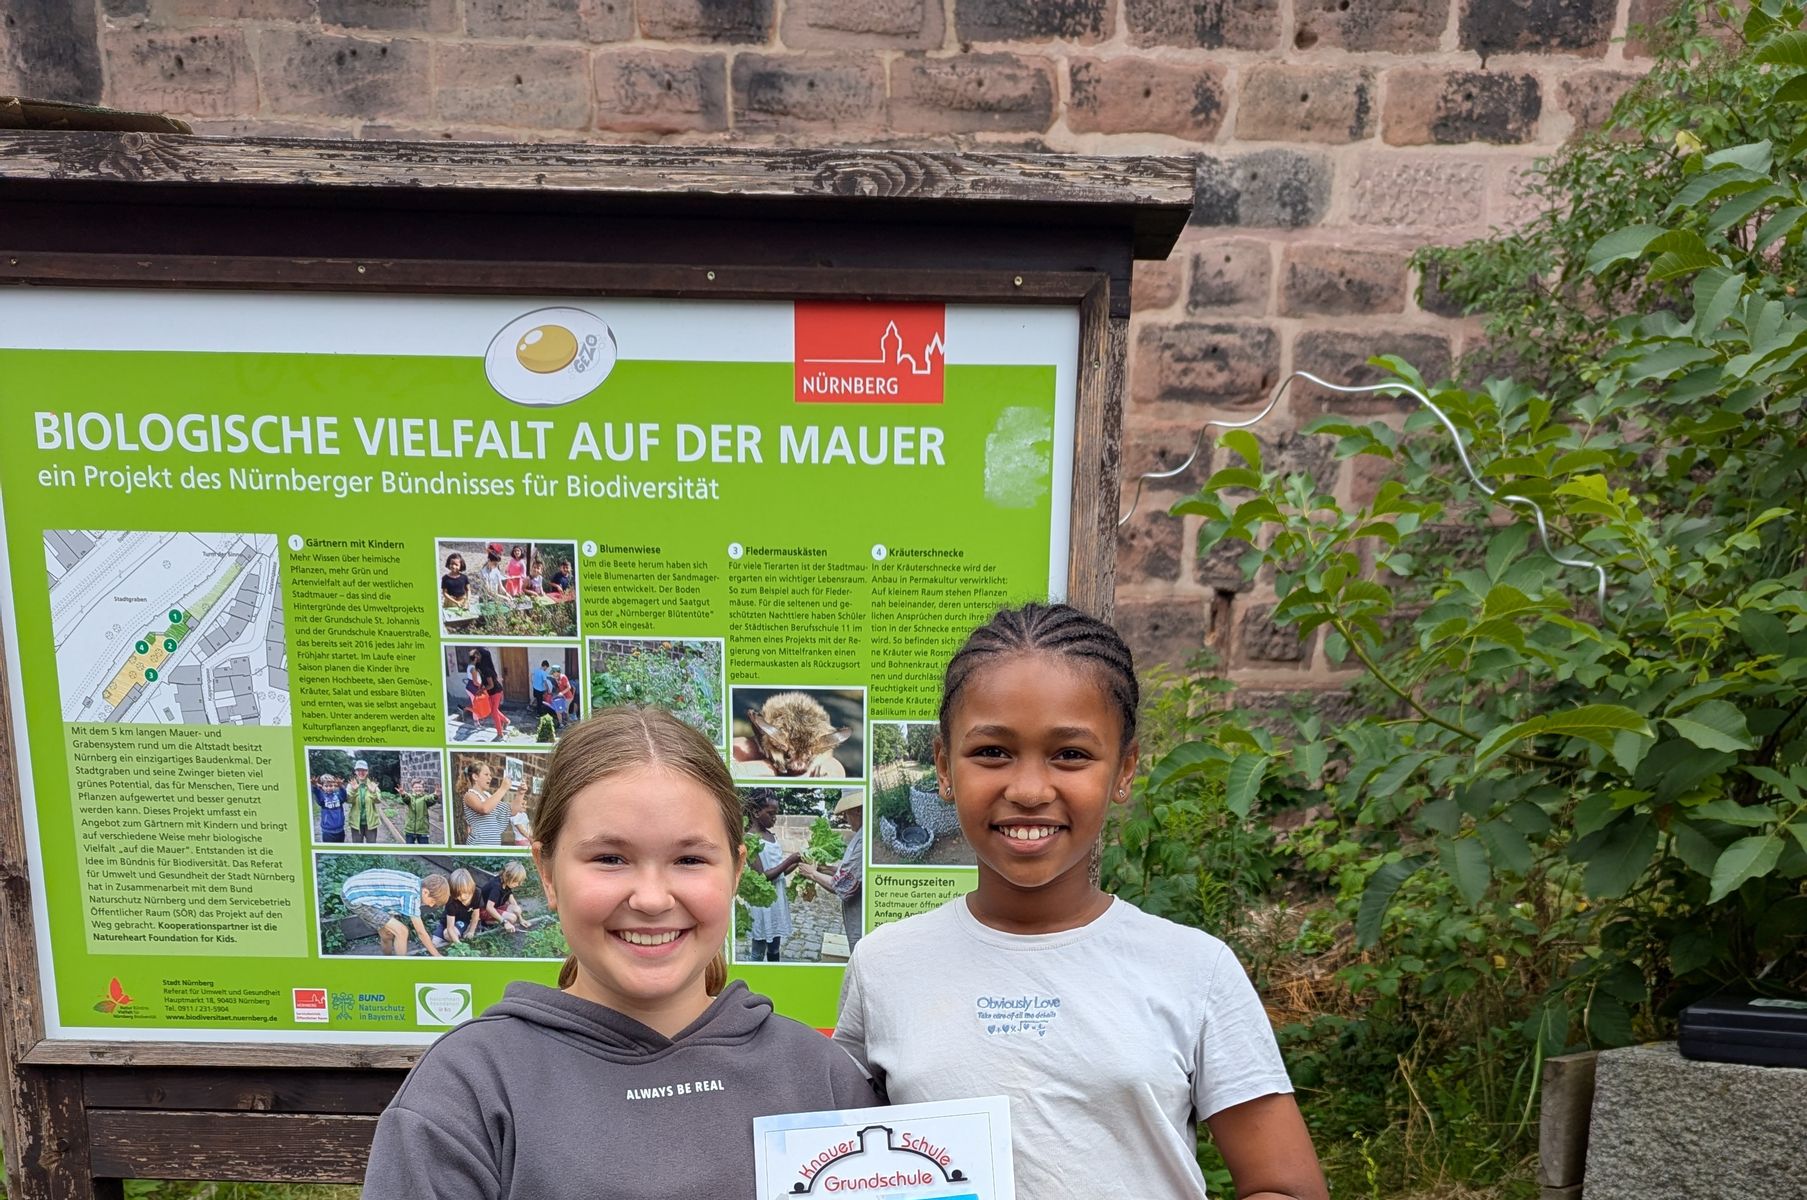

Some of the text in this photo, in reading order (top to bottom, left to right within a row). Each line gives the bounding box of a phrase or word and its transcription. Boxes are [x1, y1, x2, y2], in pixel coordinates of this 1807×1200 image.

[573, 334, 598, 373] GEZO
[803, 372, 897, 394] NÜRNBERG
[34, 411, 945, 465] BIOLOGISCHE VIELFALT AUF DER MAUER
[38, 464, 719, 499] ein Projekt des Nürnberger Bündnisses für Biodiversität
[306, 538, 347, 547] Gärtnern
[350, 538, 365, 548] mit
[367, 539, 404, 548] Kindern
[599, 544, 660, 554] Blumenwiese
[745, 546, 827, 557] Fledermauskästen
[889, 548, 963, 558] Kräuterschnecke
[289, 553, 400, 564] Mehr Wissen über heimische
[582, 559, 707, 569] Um die Beete herum haben sich
[290, 565, 388, 576] Pflanzen, mehr Grün und
[728, 561, 867, 571] Für viele Tierarten ist der Stadtmau-
[871, 562, 996, 572] In der Kräuterschnecke wird der
[583, 571, 719, 583] viele Blumenarten der Sandmager-
[728, 574, 867, 584] ergarten ein wichtiger Lebensraum.
[871, 574, 1007, 584] Anbau in Permakultur verwirklicht:
[291, 577, 413, 589] Artenvielfalt auf der westlichen
[583, 583, 700, 593] wiesen entwickelt. Der Boden
[71, 726, 221, 738] Mit dem 5 km langen Mauer- und
[72, 739, 135, 750] Grabensystem
[137, 741, 159, 749] rund
[178, 741, 192, 750] die
[194, 742, 230, 751] Altstadt
[232, 742, 262, 751] besitzt
[74, 752, 271, 765] Nürnberg ein einzigartiges Baudenkmal. Der
[874, 874, 954, 888] Öffnungszeiten
[874, 910, 903, 920] Anfang
[91, 920, 277, 932] Weg gebracht. Kooperationspartner ist die
[93, 932, 237, 942] Natureheart Foundation for Kids.
[162, 978, 214, 987] Stadt Nürnberg
[163, 987, 187, 995] Referat
[200, 987, 228, 996] Umwelt
[242, 988, 280, 997] Gesundheit
[164, 995, 270, 1006] Hauptmarkt 18, 90403 Nürnberg
[358, 993, 386, 1003] BUND
[976, 996, 1060, 1011] Obviously Love
[164, 1004, 175, 1012] Tel.
[177, 1004, 193, 1012] 0911
[199, 1004, 229, 1013] 231-5904
[358, 1003, 406, 1013] Naturschutz
[165, 1013, 277, 1022] www.biodiversitaet.nuernberg.de
[359, 1012, 406, 1023] in Bayern e.V.
[626, 1079, 724, 1100] ALWAYS BE REAL
[798, 1133, 950, 1179] Knauer Schule
[824, 1169, 932, 1191] Grundschule
